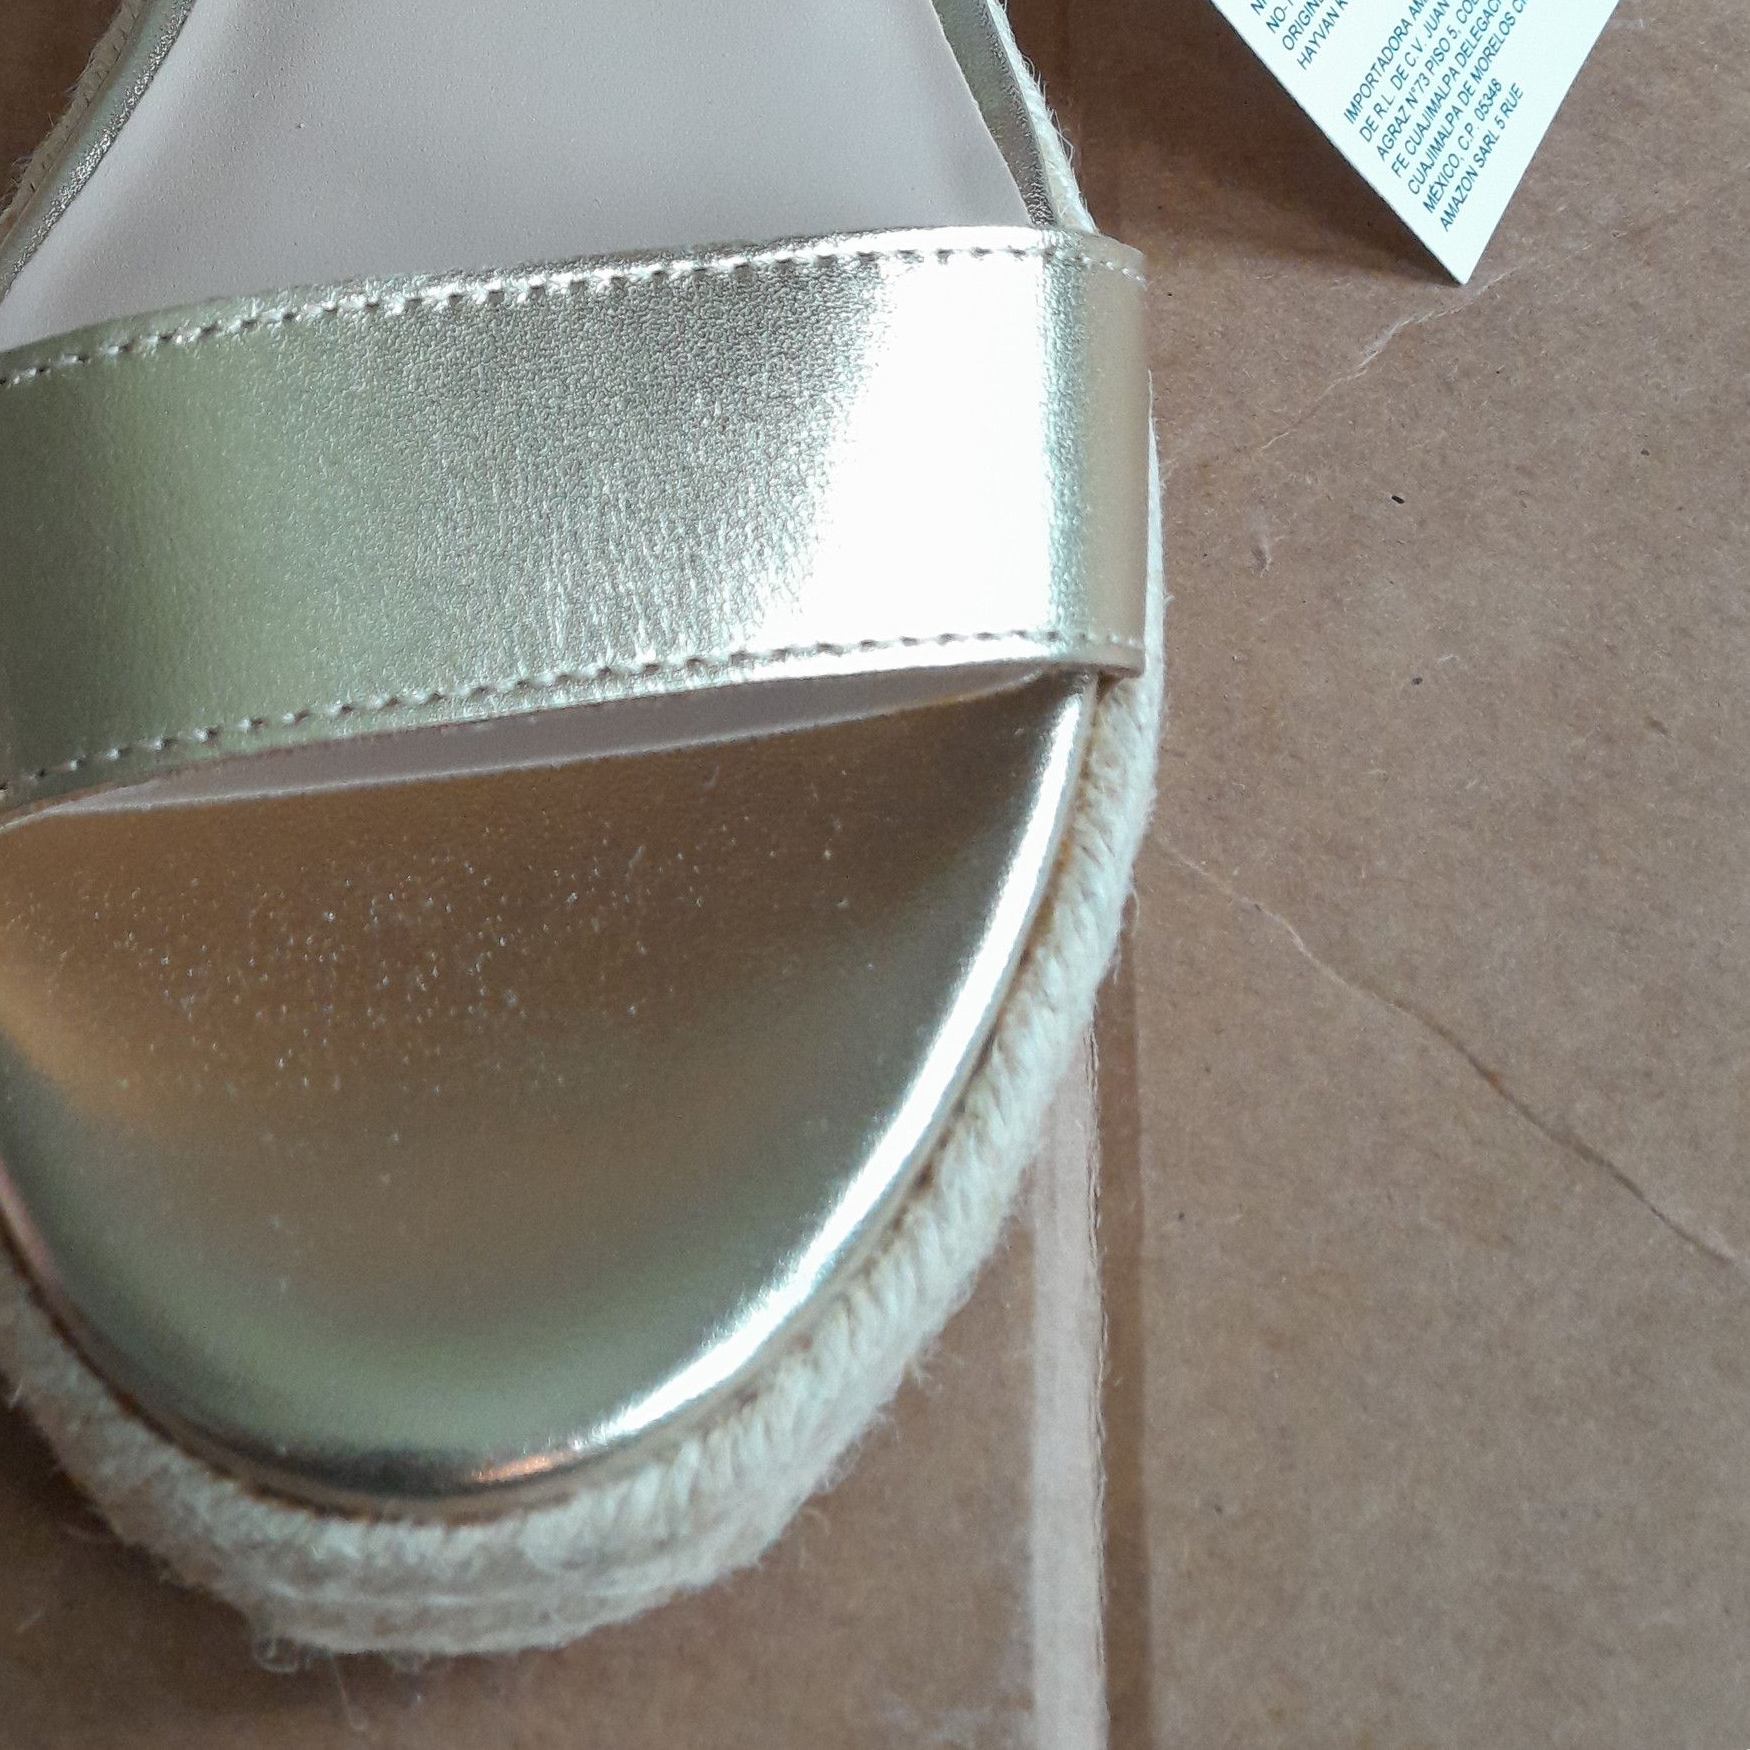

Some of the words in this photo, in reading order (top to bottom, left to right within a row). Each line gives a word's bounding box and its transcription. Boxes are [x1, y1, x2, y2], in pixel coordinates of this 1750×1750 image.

[1297, 6, 1340, 70] HAYVAN
[1343, 18, 1413, 124] IMPORTADORA
[1359, 115, 1379, 143] DE
[1390, 64, 1409, 91] DE
[1377, 104, 1411, 162] AGRAZ
[1424, 37, 1450, 76] PISO
[1446, 25, 1461, 39] 5,
[1391, 152, 1410, 178] FE
[1405, 67, 1461, 155] CUAJIMALPA
[1408, 105, 1464, 195] CUAJIMALPA
[1457, 80, 1476, 106] DE
[1470, 11, 1516, 84] MORELOS
[1494, 114, 1505, 130] 5
[1499, 82, 1523, 119] RUE
[1423, 153, 1465, 214] MÉXICO,
[1474, 78, 1502, 121] 05348
[1473, 130, 1500, 168] SARL
[1440, 165, 1479, 232] AMAZON
